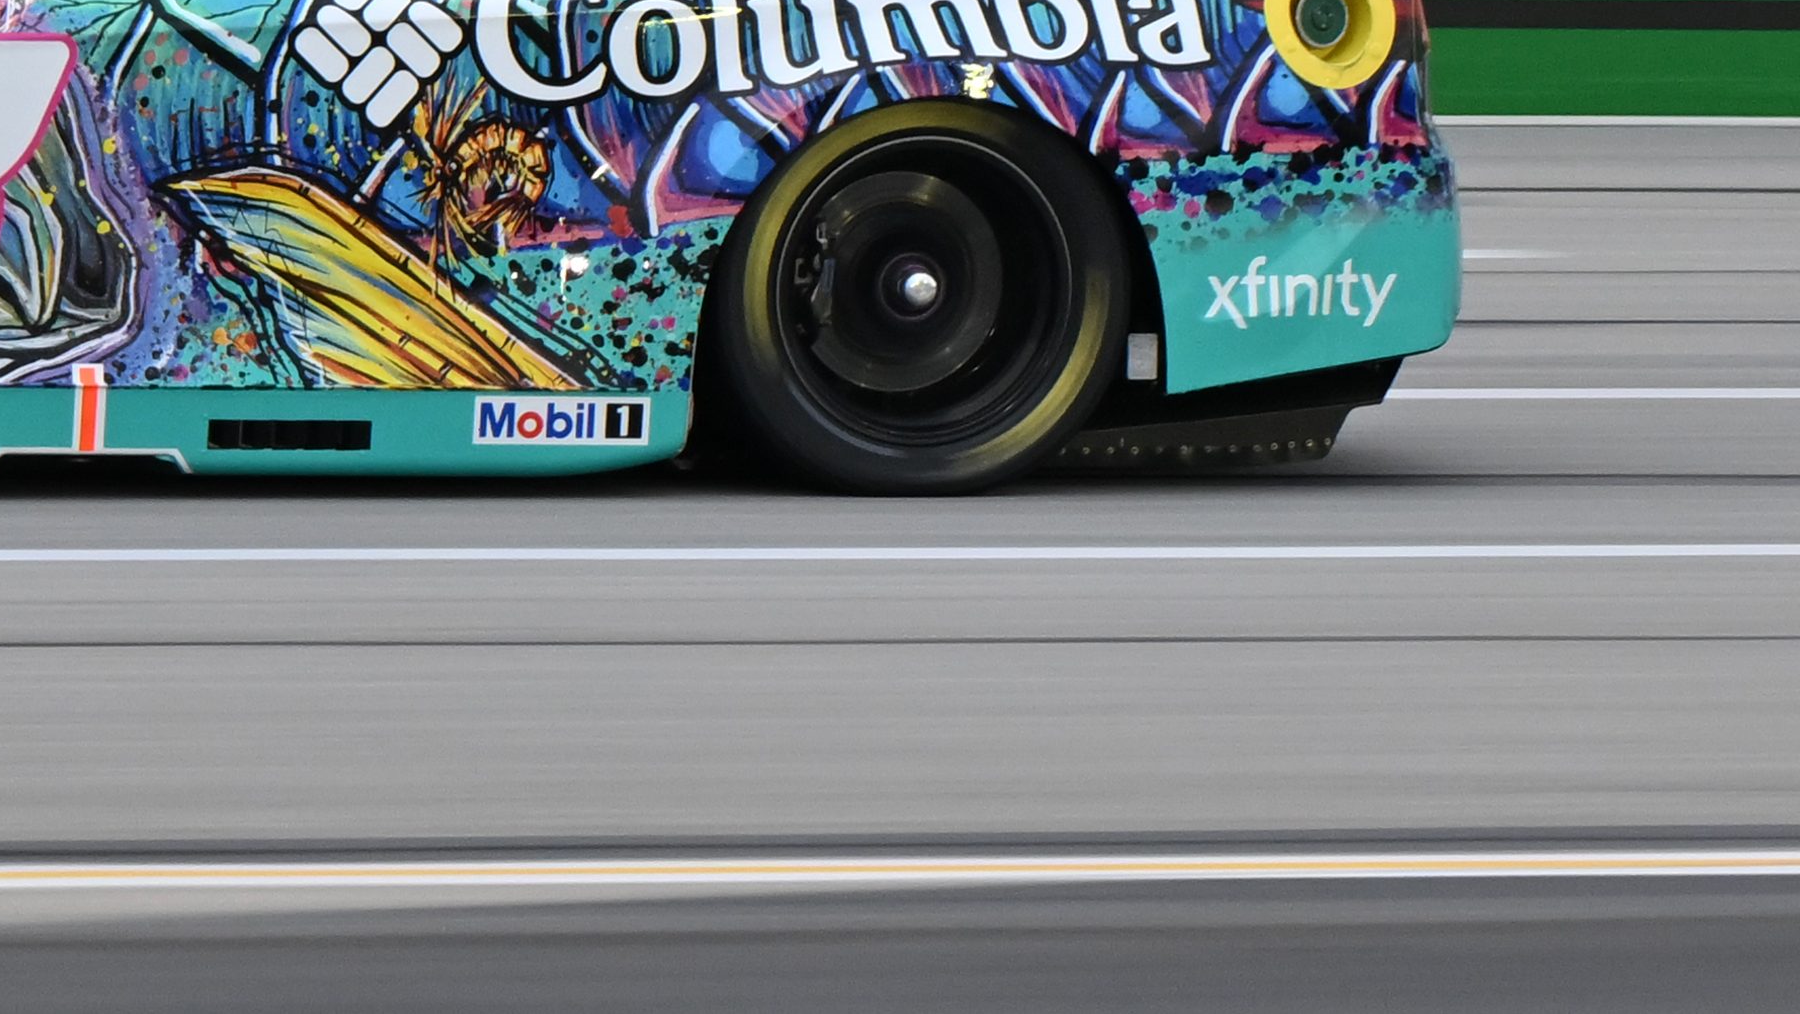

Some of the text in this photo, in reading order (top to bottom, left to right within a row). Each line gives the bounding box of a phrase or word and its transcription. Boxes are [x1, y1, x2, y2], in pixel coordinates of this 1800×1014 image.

[1204, 255, 1398, 330] xfinity
[479, 402, 631, 439] Mobil 1
